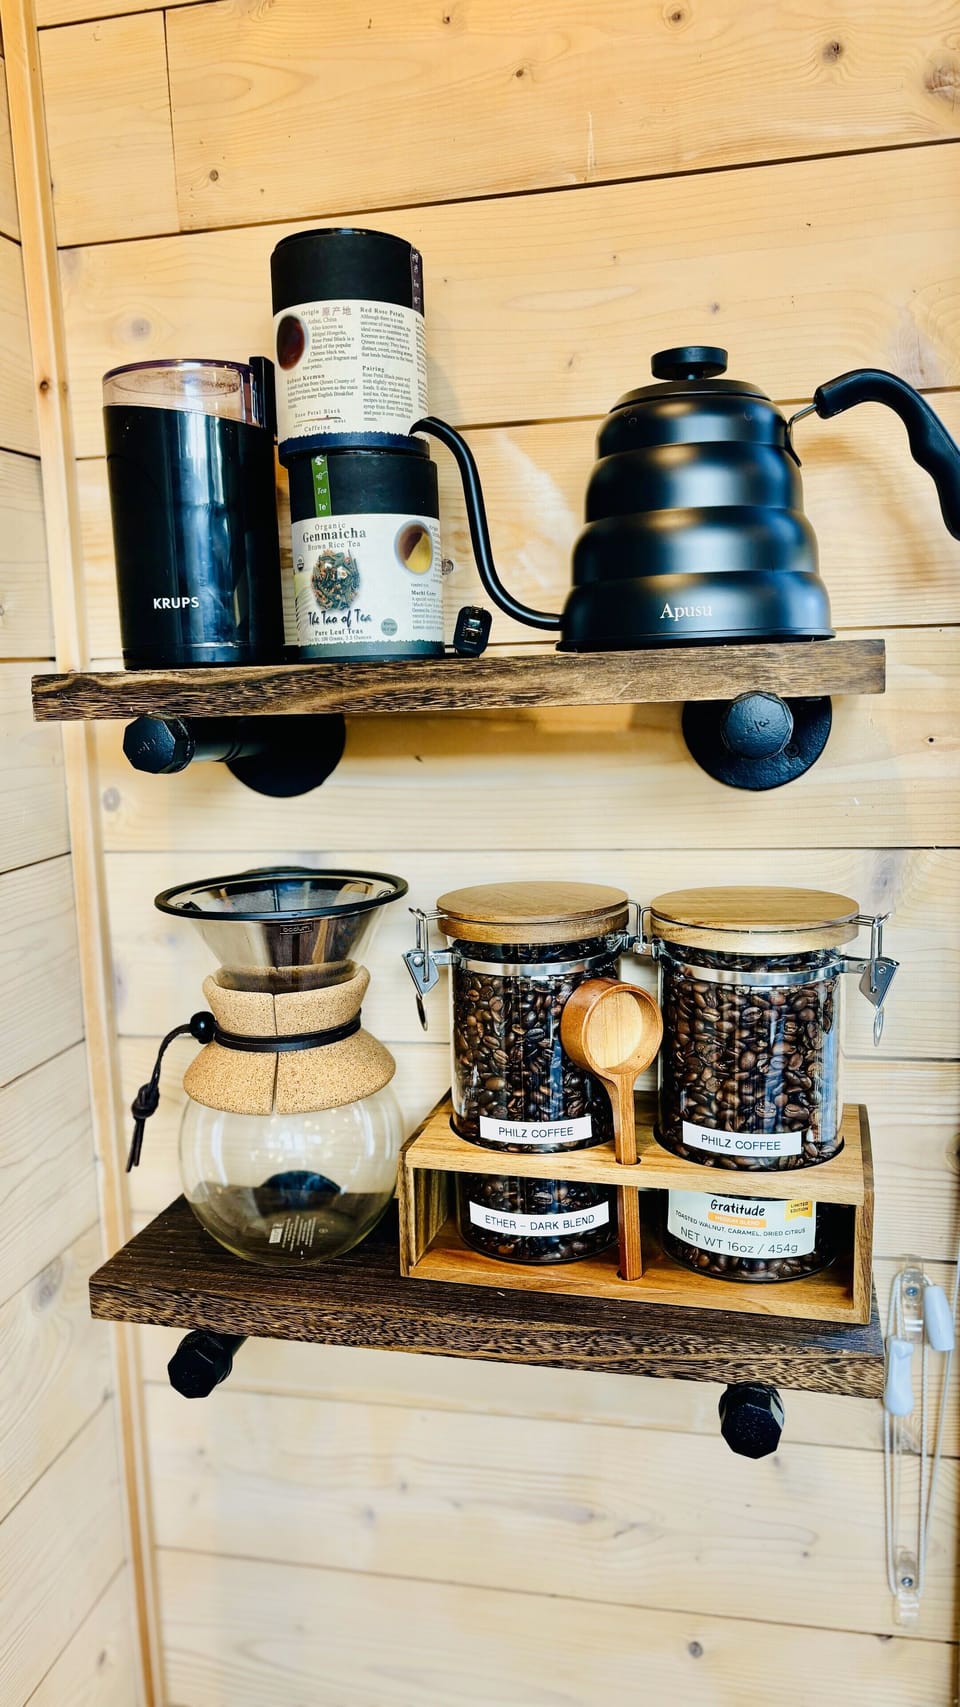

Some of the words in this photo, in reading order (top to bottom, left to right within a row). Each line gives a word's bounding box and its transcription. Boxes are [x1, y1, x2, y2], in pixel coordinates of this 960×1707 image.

[302, 527, 367, 543] Genmaicha
[315, 522, 346, 531] Organic
[328, 541, 345, 549] Rice
[347, 540, 361, 548] Tea
[153, 596, 200, 610] KRUPS
[308, 611, 320, 626] The
[321, 610, 338, 624] Tao
[341, 609, 352, 628] of
[354, 608, 373, 624] Tea
[660, 602, 713, 622] Apusu
[498, 1126, 528, 1138] PHILZ
[531, 1126, 574, 1138] COFFEE
[701, 1133, 732, 1149] PHILZ
[735, 1140, 781, 1151] COFFEE
[710, 1199, 766, 1217] Gratitude
[485, 1214, 517, 1230] ETHER
[530, 1220, 560, 1231] DARK
[563, 1214, 595, 1229] BLEND
[675, 1209, 698, 1225] TOASTED
[785, 1228, 806, 1236] CITRUS
[680, 1226, 701, 1242] NET
[703, 1235, 724, 1249] WT
[727, 1241, 754, 1254] 16oz
[757, 1243, 765, 1255] /
[767, 1244, 799, 1254] 454g
